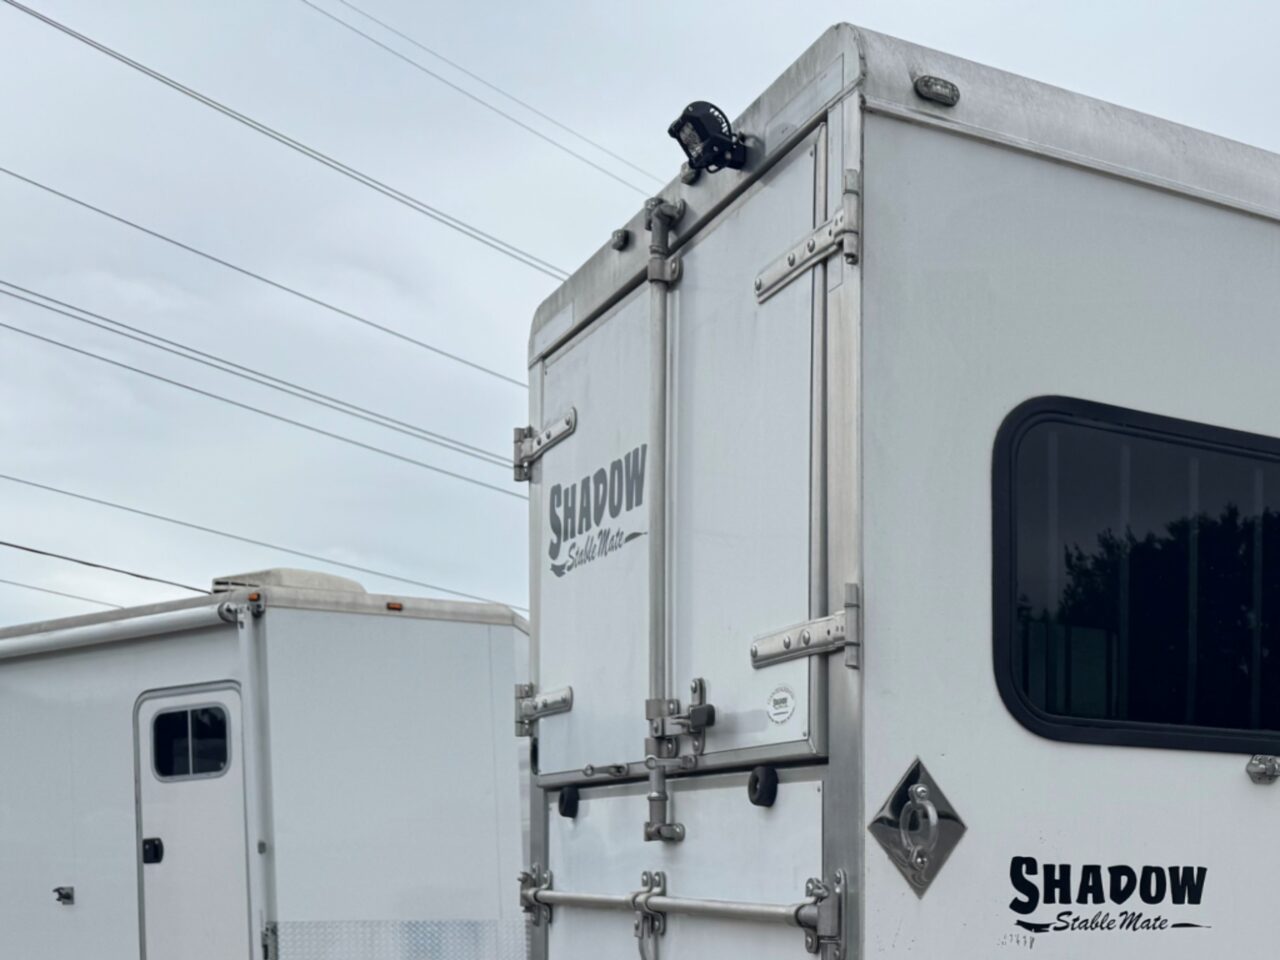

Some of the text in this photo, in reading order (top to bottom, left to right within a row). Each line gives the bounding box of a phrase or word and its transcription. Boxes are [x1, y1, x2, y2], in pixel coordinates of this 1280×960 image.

[548, 443, 648, 561] SHADOW
[566, 527, 625, 572] Stable Mate
[1008, 855, 1208, 915] SHADOW
[1052, 910, 1169, 932] Stable Mate
